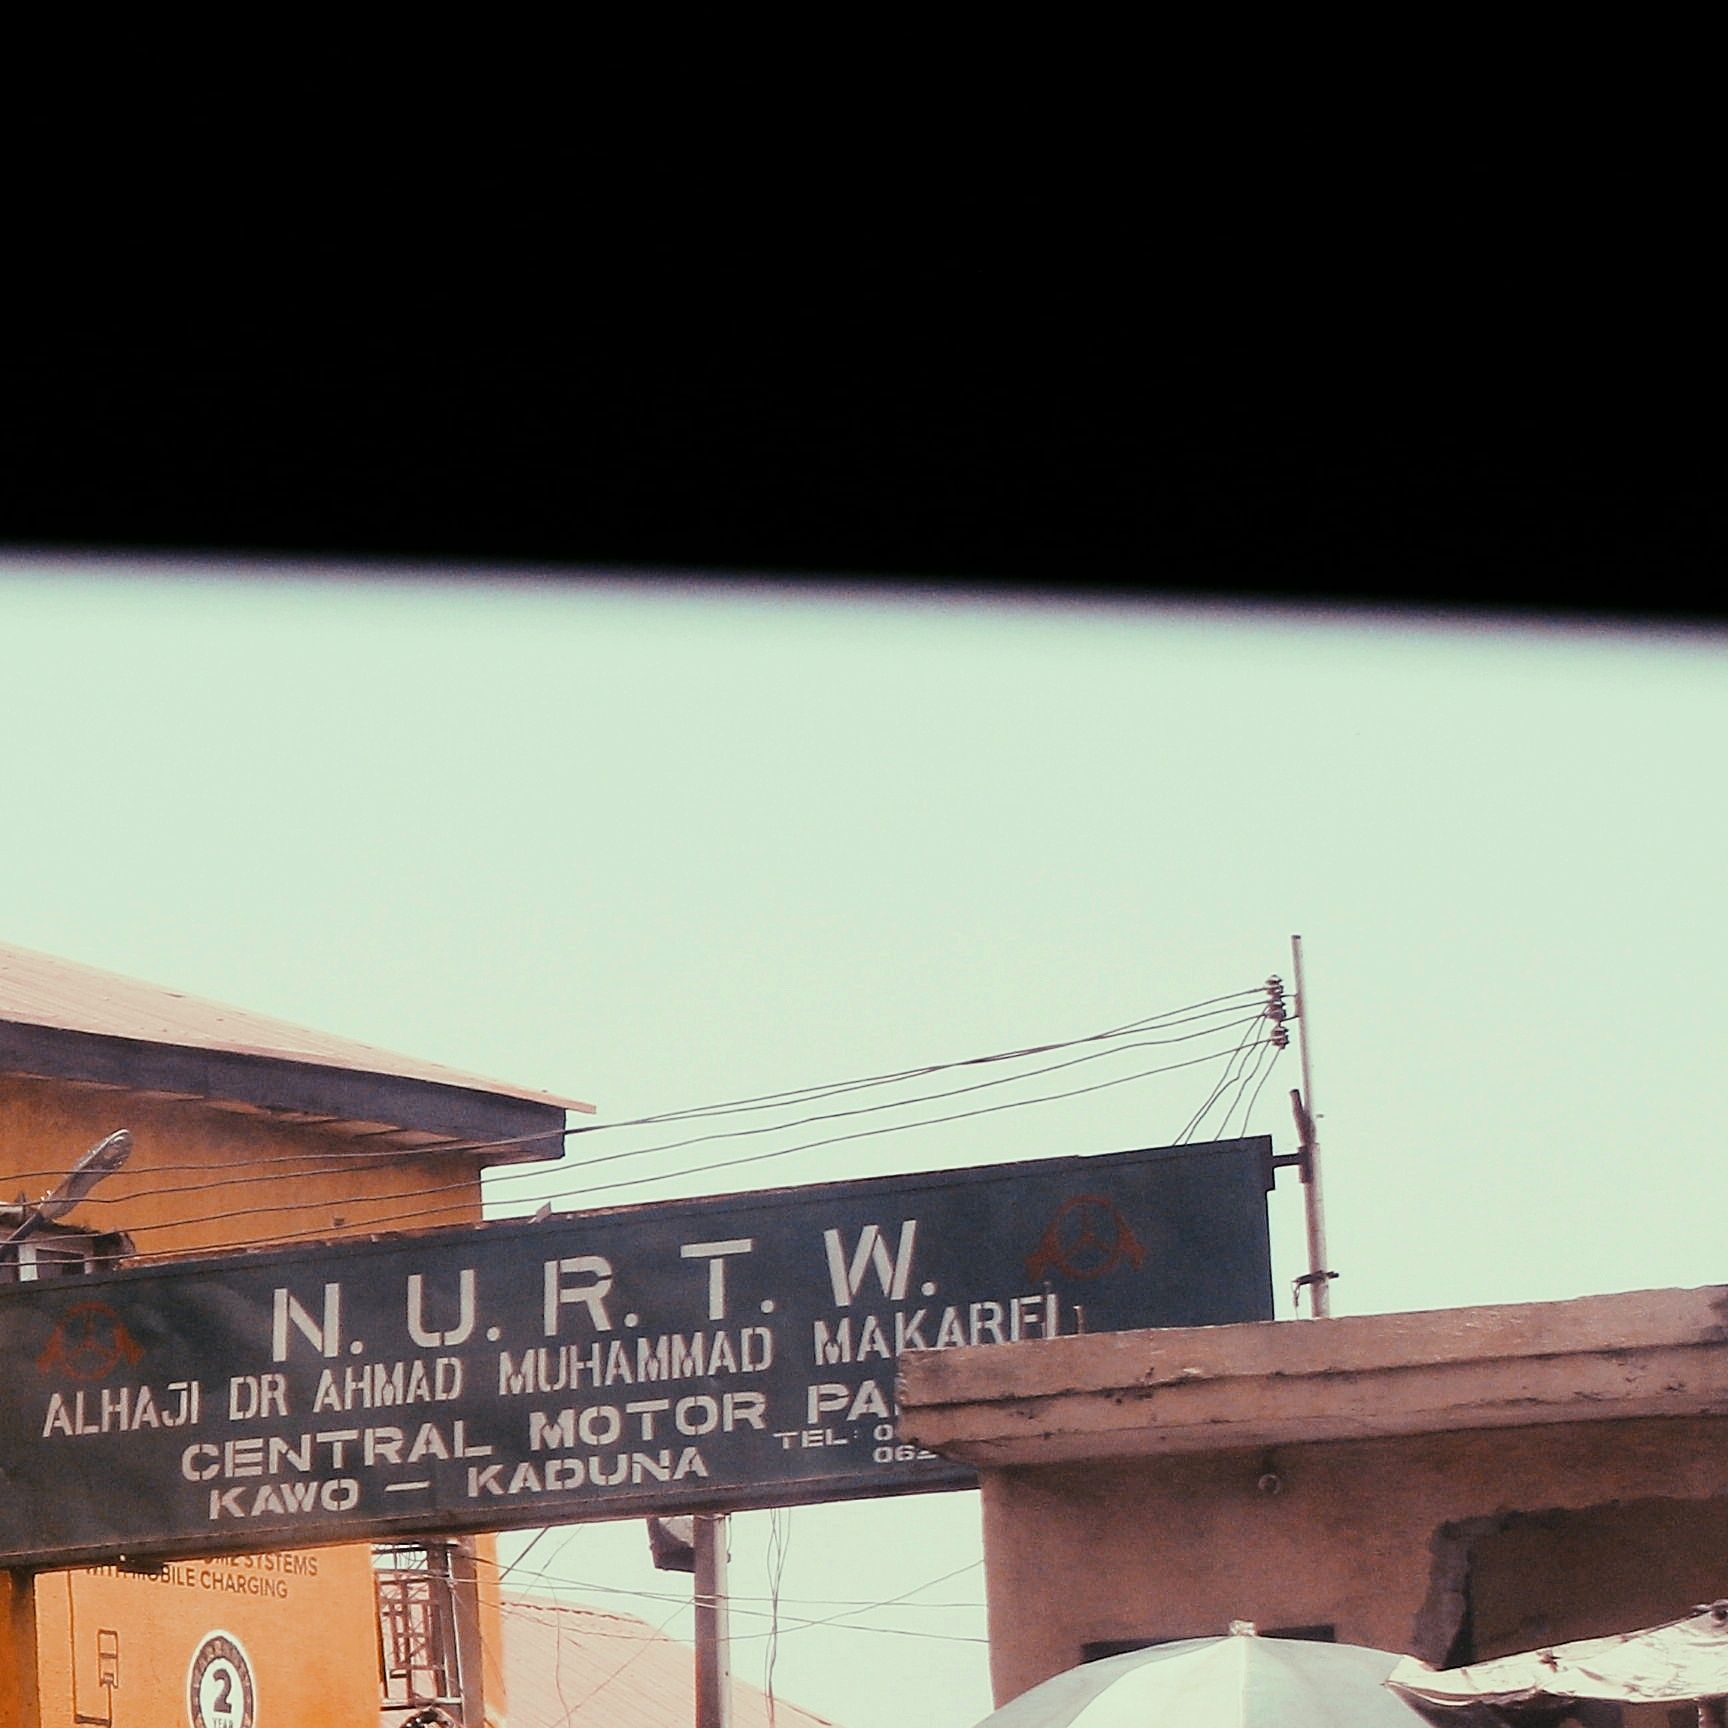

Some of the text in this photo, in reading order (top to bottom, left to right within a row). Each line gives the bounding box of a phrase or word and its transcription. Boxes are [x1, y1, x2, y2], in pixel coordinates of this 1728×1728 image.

[272, 1219, 938, 1363] N. U. R. T. W.
[42, 1380, 200, 1438] ALHAJI
[228, 1374, 288, 1421] DR
[313, 1357, 463, 1413] AHMAD
[498, 1325, 775, 1396] MUHAMMAD
[181, 1378, 899, 1483] CENTRAL MOTOR PA
[209, 1477, 360, 1520] KAWO
[467, 1445, 709, 1499] KADUNA
[200, 1570, 288, 1599] CHARGING
[213, 1668, 233, 1714] 2
